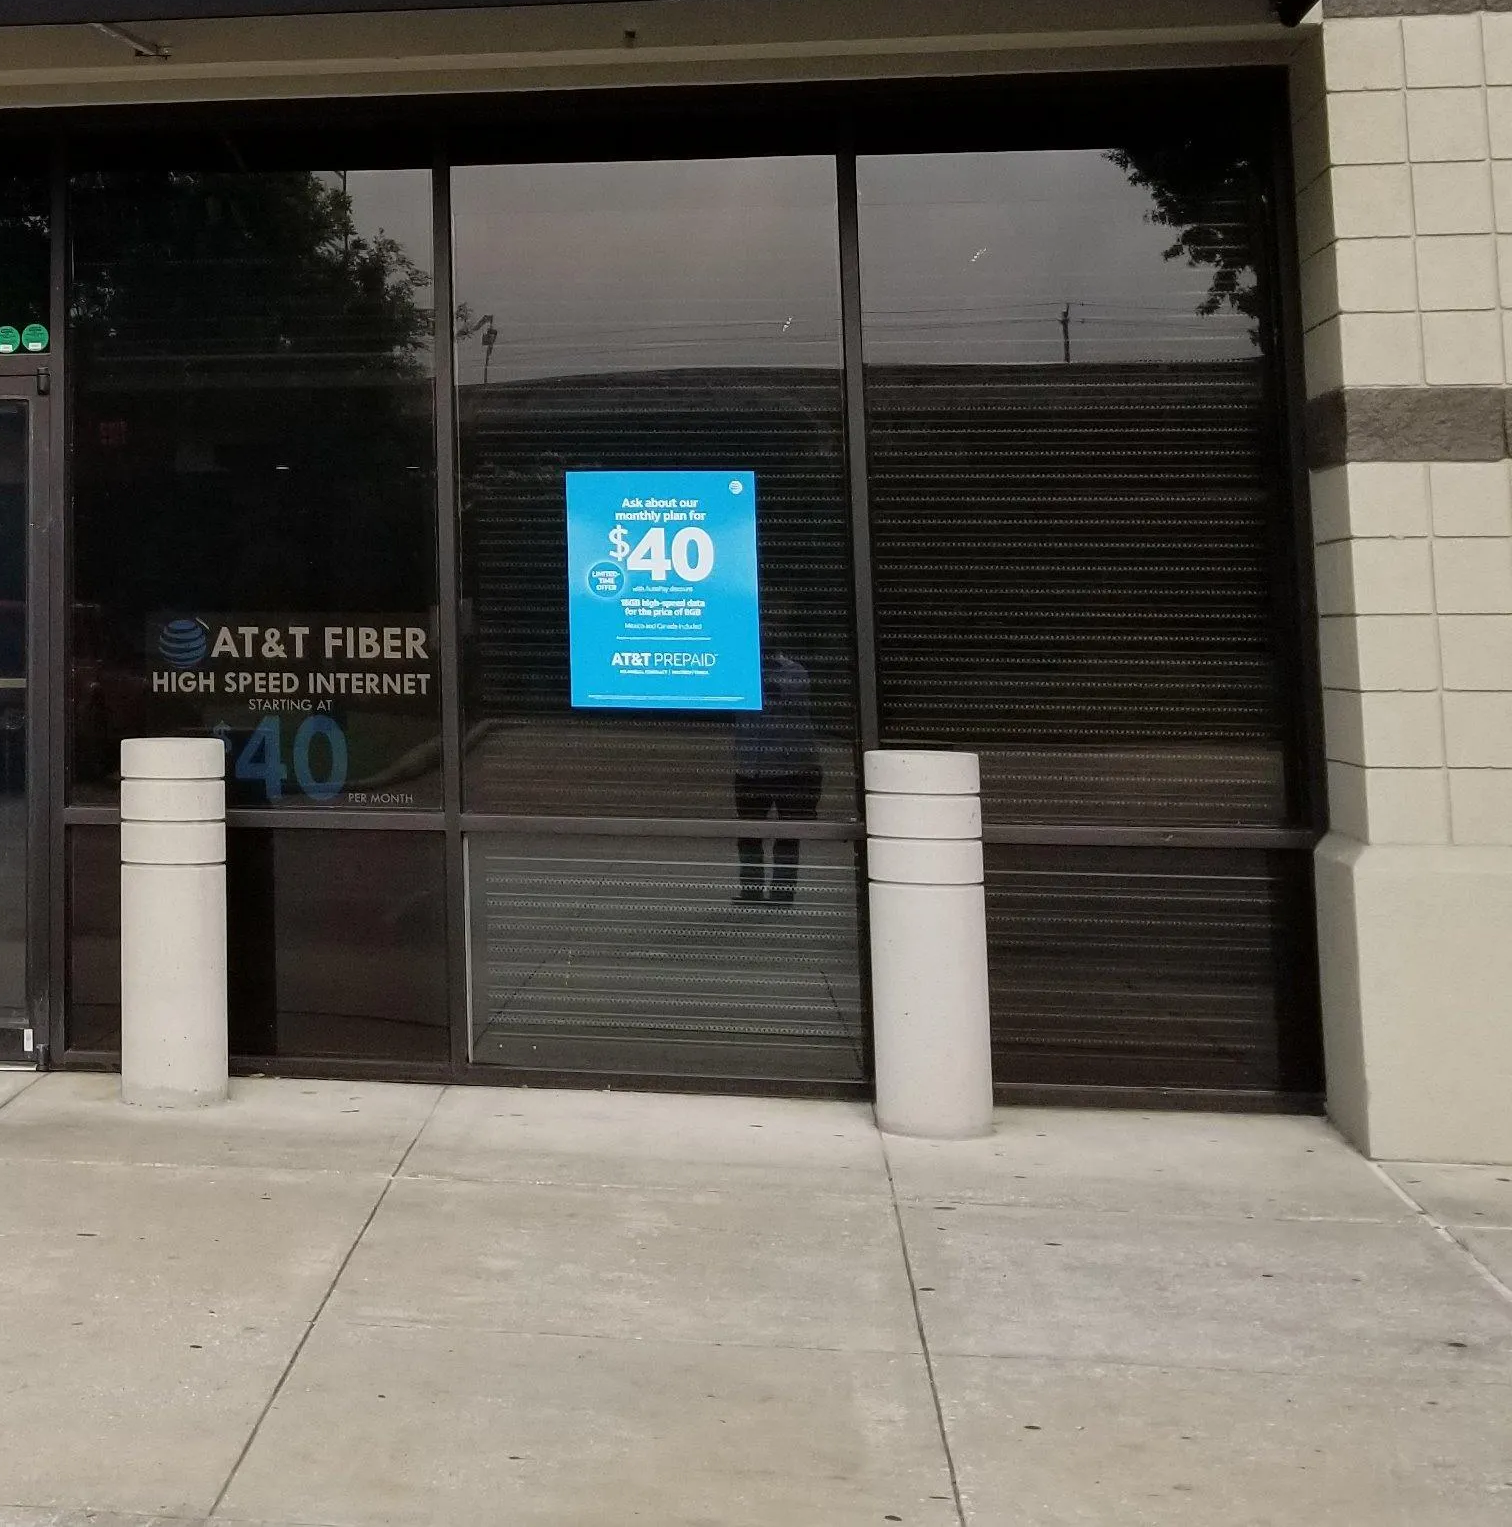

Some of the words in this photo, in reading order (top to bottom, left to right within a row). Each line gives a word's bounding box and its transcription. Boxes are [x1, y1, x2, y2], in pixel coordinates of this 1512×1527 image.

[621, 498, 643, 508] Ask
[645, 498, 677, 508] about
[679, 499, 699, 508] our
[615, 510, 661, 523] monthly
[663, 510, 687, 523] plan
[689, 510, 707, 521] for
[608, 524, 715, 582] $40
[624, 607, 637, 616] for
[638, 607, 652, 616] the
[653, 608, 673, 618] price
[211, 626, 310, 658] AT&T
[324, 627, 429, 659] FIBER
[611, 652, 651, 667] AT&T
[152, 671, 215, 693] HIGH
[224, 672, 299, 694] SPEED
[309, 673, 431, 695] INTERNET
[248, 698, 313, 711] STARTING
[316, 699, 333, 712] AT
[348, 792, 367, 804] PER
[370, 793, 414, 804] MONTH
